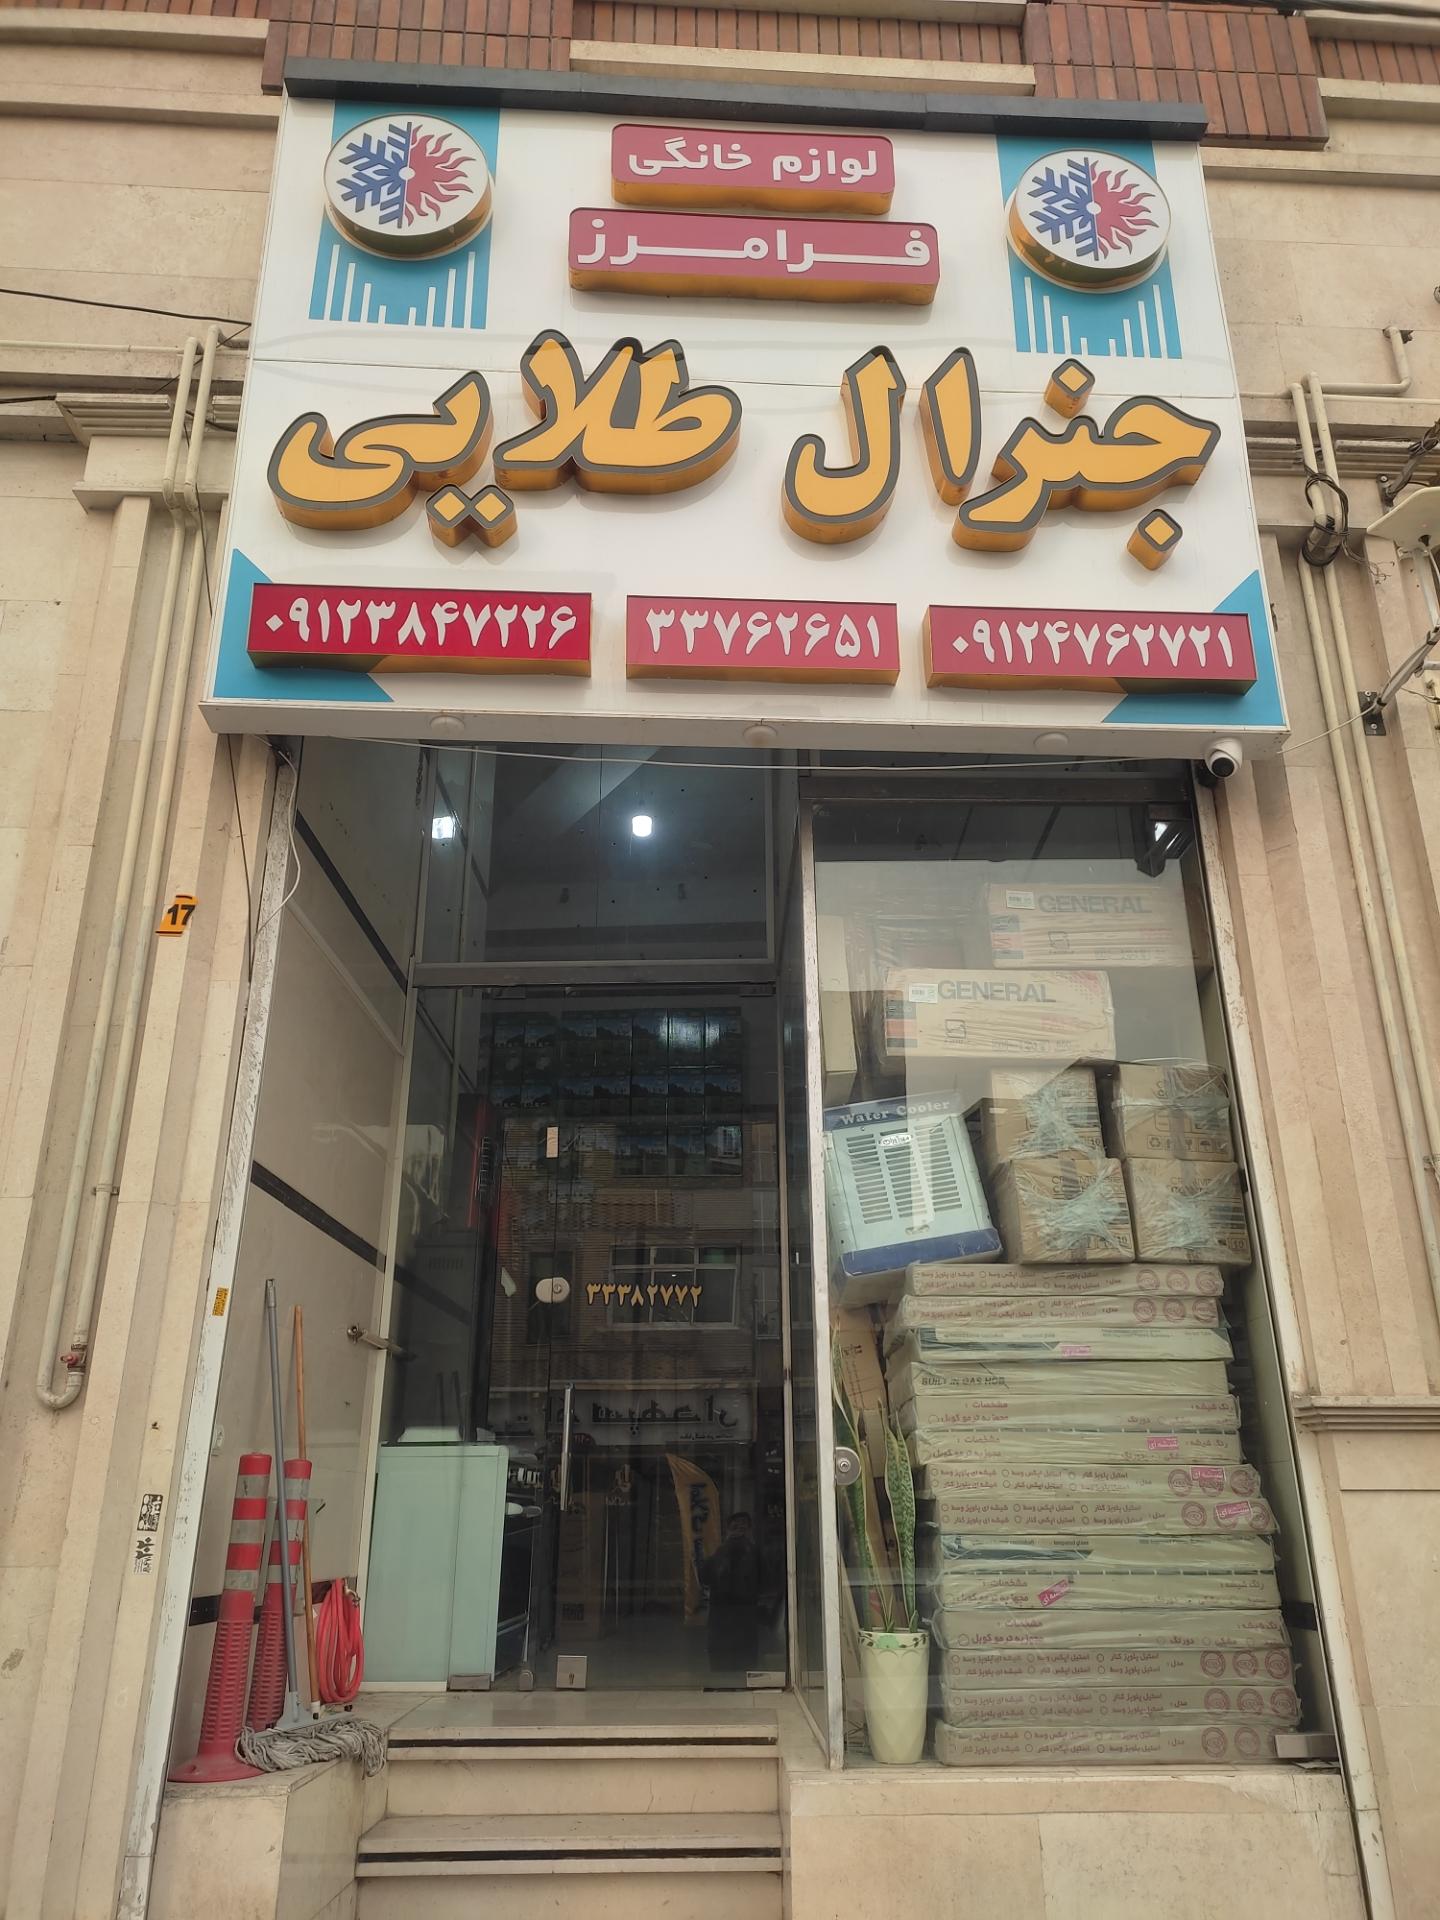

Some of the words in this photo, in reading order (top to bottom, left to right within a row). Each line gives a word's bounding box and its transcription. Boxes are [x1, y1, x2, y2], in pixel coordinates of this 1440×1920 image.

[628, 137, 753, 176] خانگی
[772, 148, 878, 184] لوازم
[576, 218, 931, 273] فرامرز
[267, 329, 742, 538] طلایی
[785, 345, 1221, 560] جنرال
[265, 597, 577, 650] ۰۹۱۲۳۸۴۷۲۲۶
[645, 608, 880, 658] ۳۳۷۶۲۶۵۱
[952, 619, 1233, 668] ۰۹۱۲۴۷۶۲۷۲۱
[167, 903, 196, 926] 17
[1038, 895, 1152, 914] GENERAL
[937, 980, 1057, 1003] GENERAL
[841, 1110, 889, 1125] Water
[896, 1101, 950, 1116] Cooler
[586, 1282, 703, 1308] ۳۳۳۸۲۷۷۲
